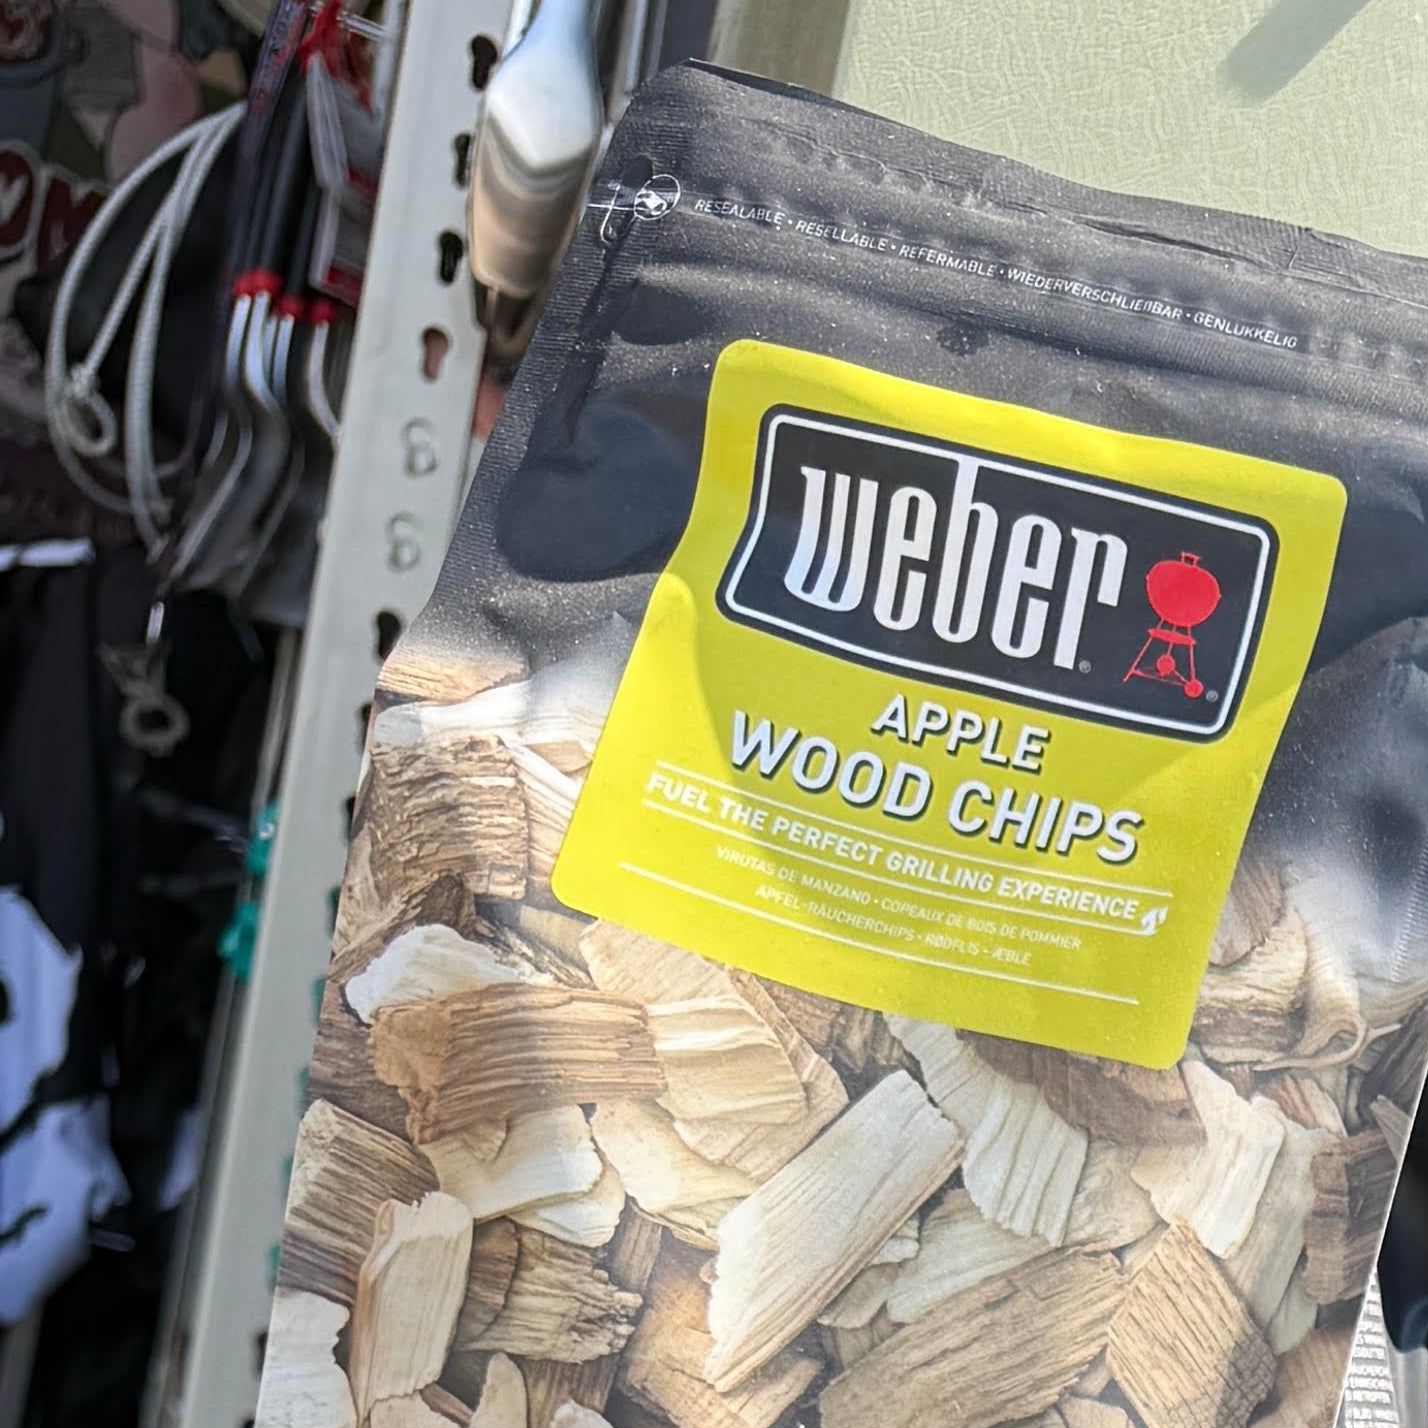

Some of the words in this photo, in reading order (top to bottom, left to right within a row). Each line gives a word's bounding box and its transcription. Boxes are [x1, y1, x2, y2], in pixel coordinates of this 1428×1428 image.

[694, 196, 784, 226] RESEALABLE
[796, 219, 886, 251] RESELLABLE
[899, 243, 998, 277] REFERMABLE
[1193, 311, 1297, 349] GENLUKKELIG
[783, 460, 1127, 672] weber
[731, 710, 933, 822] WOOD
[949, 776, 1145, 863] CHIPS
[872, 695, 1051, 774] APPLE
[645, 772, 715, 812] FUEL
[715, 796, 768, 830] THE
[768, 815, 882, 865] PERFECT
[884, 849, 993, 894] GRILLING
[997, 875, 1137, 918] EXPERIENCE
